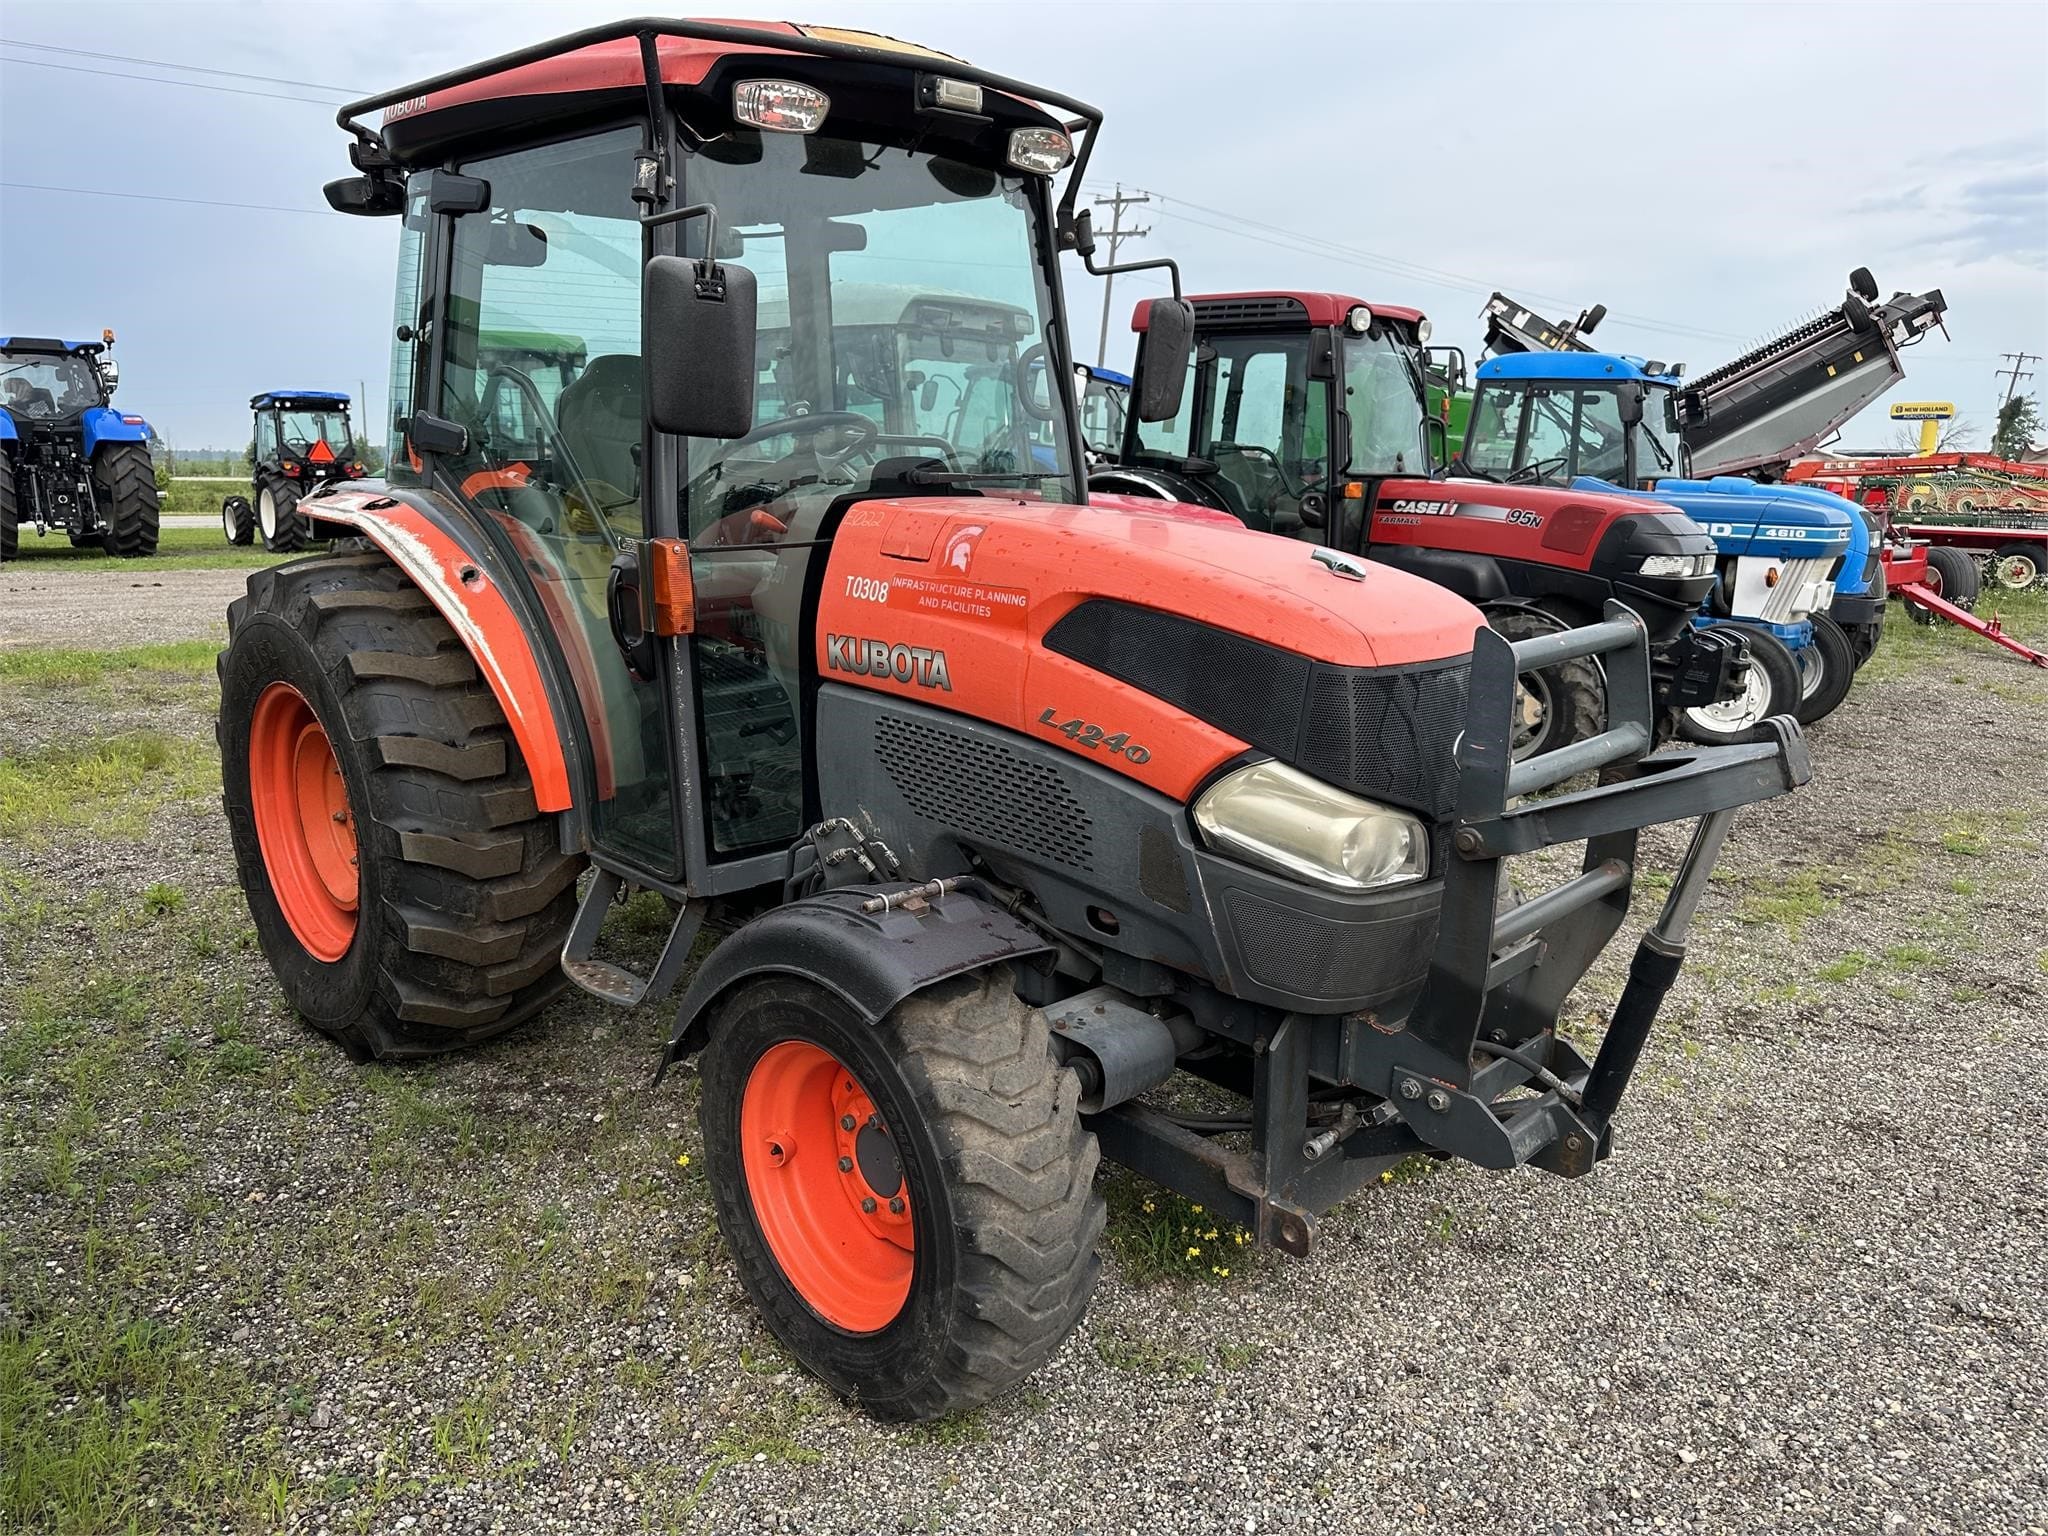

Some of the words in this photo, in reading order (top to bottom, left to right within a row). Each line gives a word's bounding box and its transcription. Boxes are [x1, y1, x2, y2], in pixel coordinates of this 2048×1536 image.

[1378, 516, 1421, 525] FARMALL
[1765, 529, 1807, 538] 4610
[845, 575, 889, 603] T0308
[892, 576, 972, 598] INFRASTRUCTURE
[975, 587, 1026, 607] PLANNING
[919, 595, 939, 609] AND
[941, 599, 991, 618] FACILITIES
[827, 633, 953, 692] KUBOTA
[1038, 707, 1151, 765] L4240
